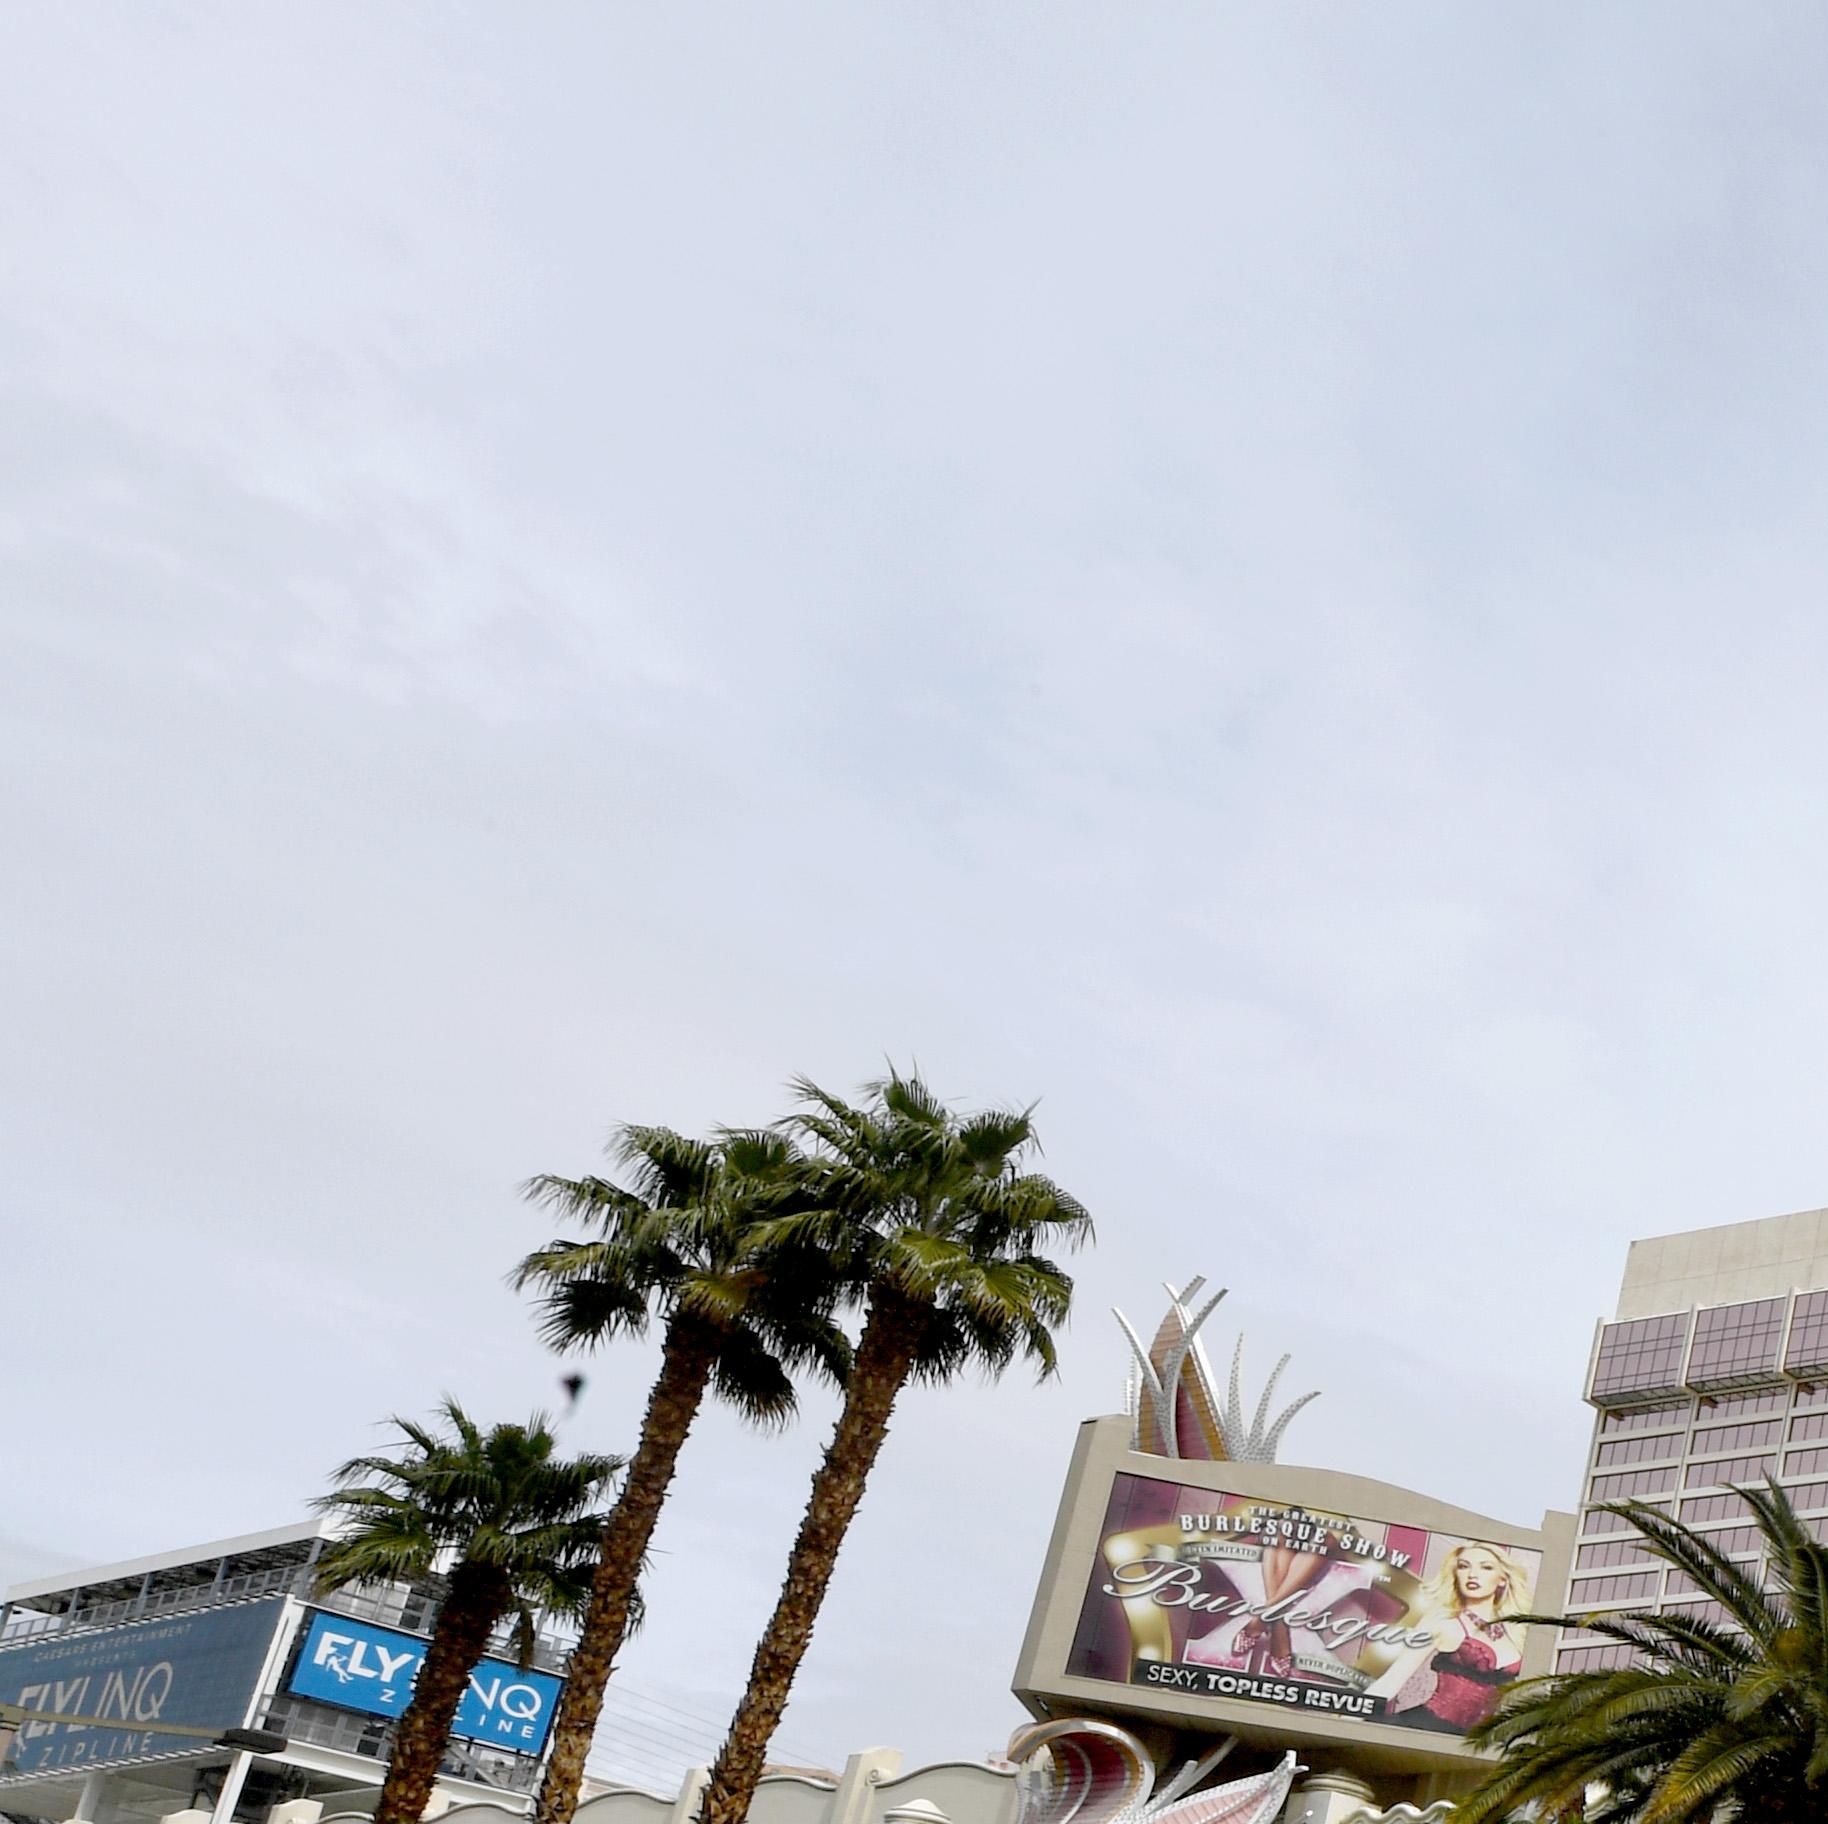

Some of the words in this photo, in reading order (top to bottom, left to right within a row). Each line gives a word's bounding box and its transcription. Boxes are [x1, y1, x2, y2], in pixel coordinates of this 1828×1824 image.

[1249, 1505, 1276, 1519] THE
[1282, 1509, 1355, 1532] GREATEST
[1180, 1513, 1328, 1545] BURLESQUE
[1339, 1533, 1412, 1570] SHOW
[1213, 1545, 1258, 1558] IMITATED
[1262, 1535, 1279, 1547] ON
[1283, 1538, 1330, 1556] EARTH
[1102, 1558, 1435, 1651] Burlesque
[90, 1623, 193, 1652] ENTERTAINMENT
[1298, 1657, 1324, 1669] NEVER
[1147, 1664, 1199, 1691] SEXY,
[1206, 1673, 1300, 1703] TOPLESS
[1304, 1689, 1375, 1715] REVUE
[38, 1731, 155, 1768] ZIPLINE
